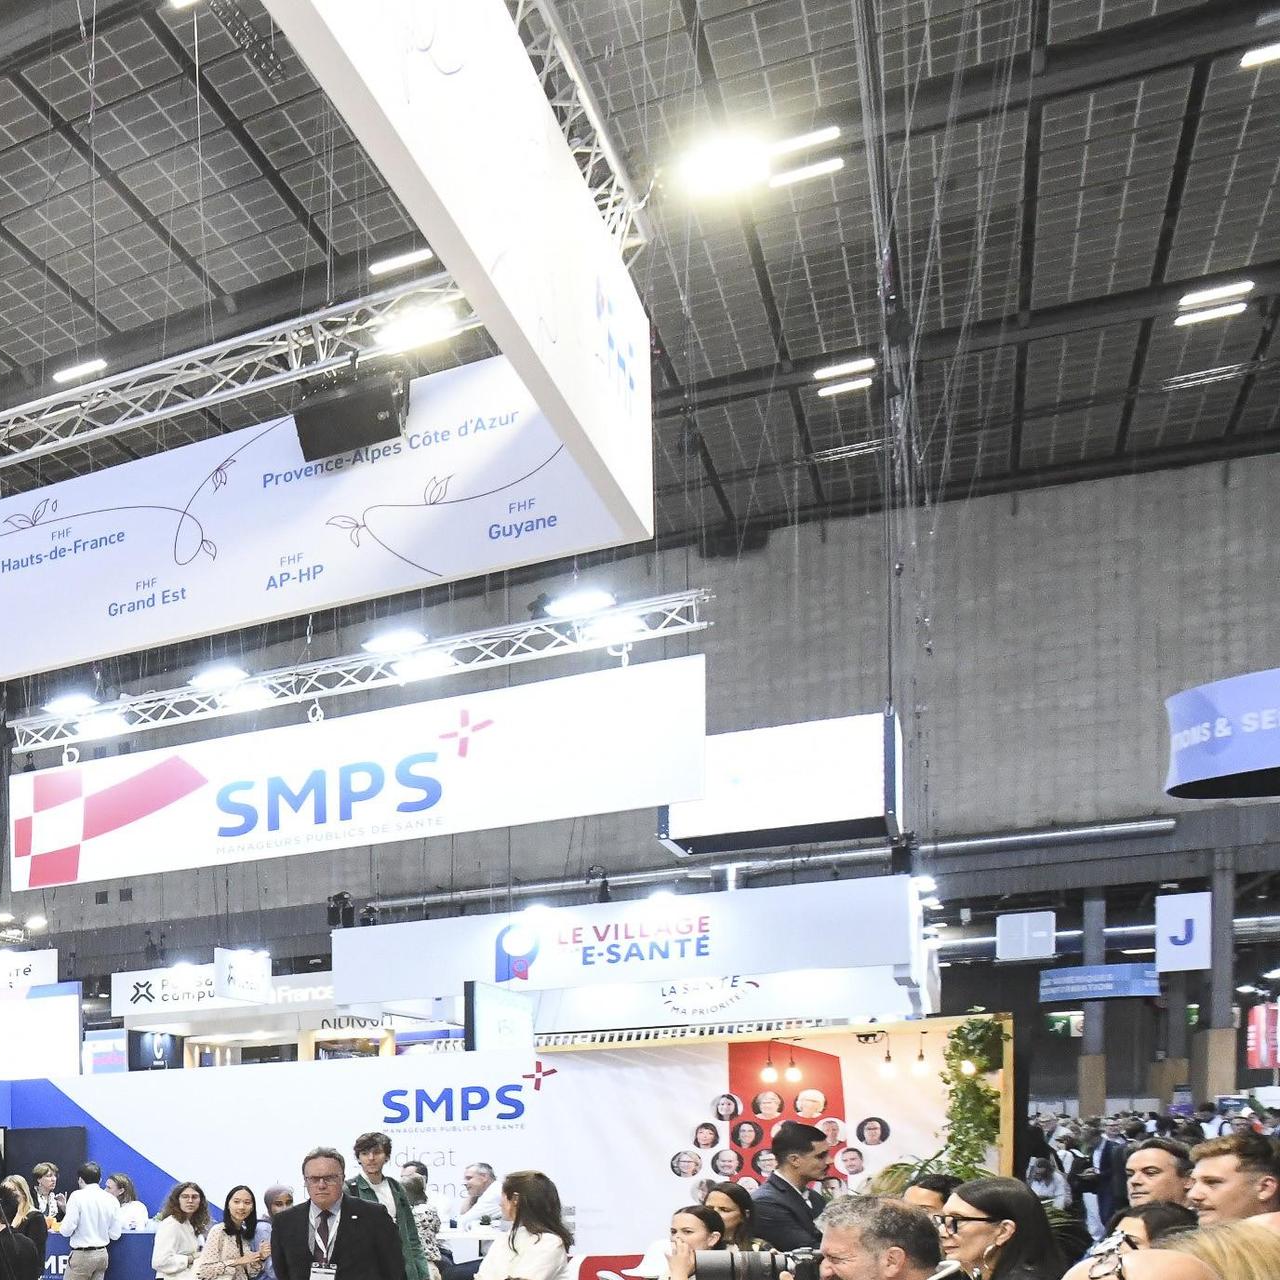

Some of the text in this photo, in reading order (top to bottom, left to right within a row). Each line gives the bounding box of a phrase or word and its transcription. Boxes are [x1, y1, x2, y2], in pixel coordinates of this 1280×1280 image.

[262, 409, 520, 488] Provence-Alpes Côte d'Azur
[508, 498, 536, 514] FHF
[51, 526, 72, 541] FHF
[488, 513, 559, 540] Guyane
[1, 529, 126, 574] Hauts-de-France
[279, 552, 305, 568] FHF
[135, 577, 158, 592] FHF
[265, 563, 325, 591] AP-HP
[107, 586, 187, 617] Grand Est
[1214, 717, 1233, 738] &
[1242, 707, 1280, 733] SE
[215, 752, 443, 838] SMPS
[216, 836, 302, 855] MANAGEURS
[306, 828, 365, 843] PUBLICS
[371, 824, 390, 834] DE
[557, 915, 711, 945] LE VILLAGE
[1169, 918, 1195, 946] J
[581, 934, 711, 966] E-SANTÉ
[661, 985, 677, 997] LA
[382, 1084, 526, 1124] SMPS
[383, 1126, 437, 1134] MANAGEURS
[496, 1121, 526, 1130] SANTÉ
[393, 1146, 457, 1169] dicat
[44, 1255, 70, 1275] MP
